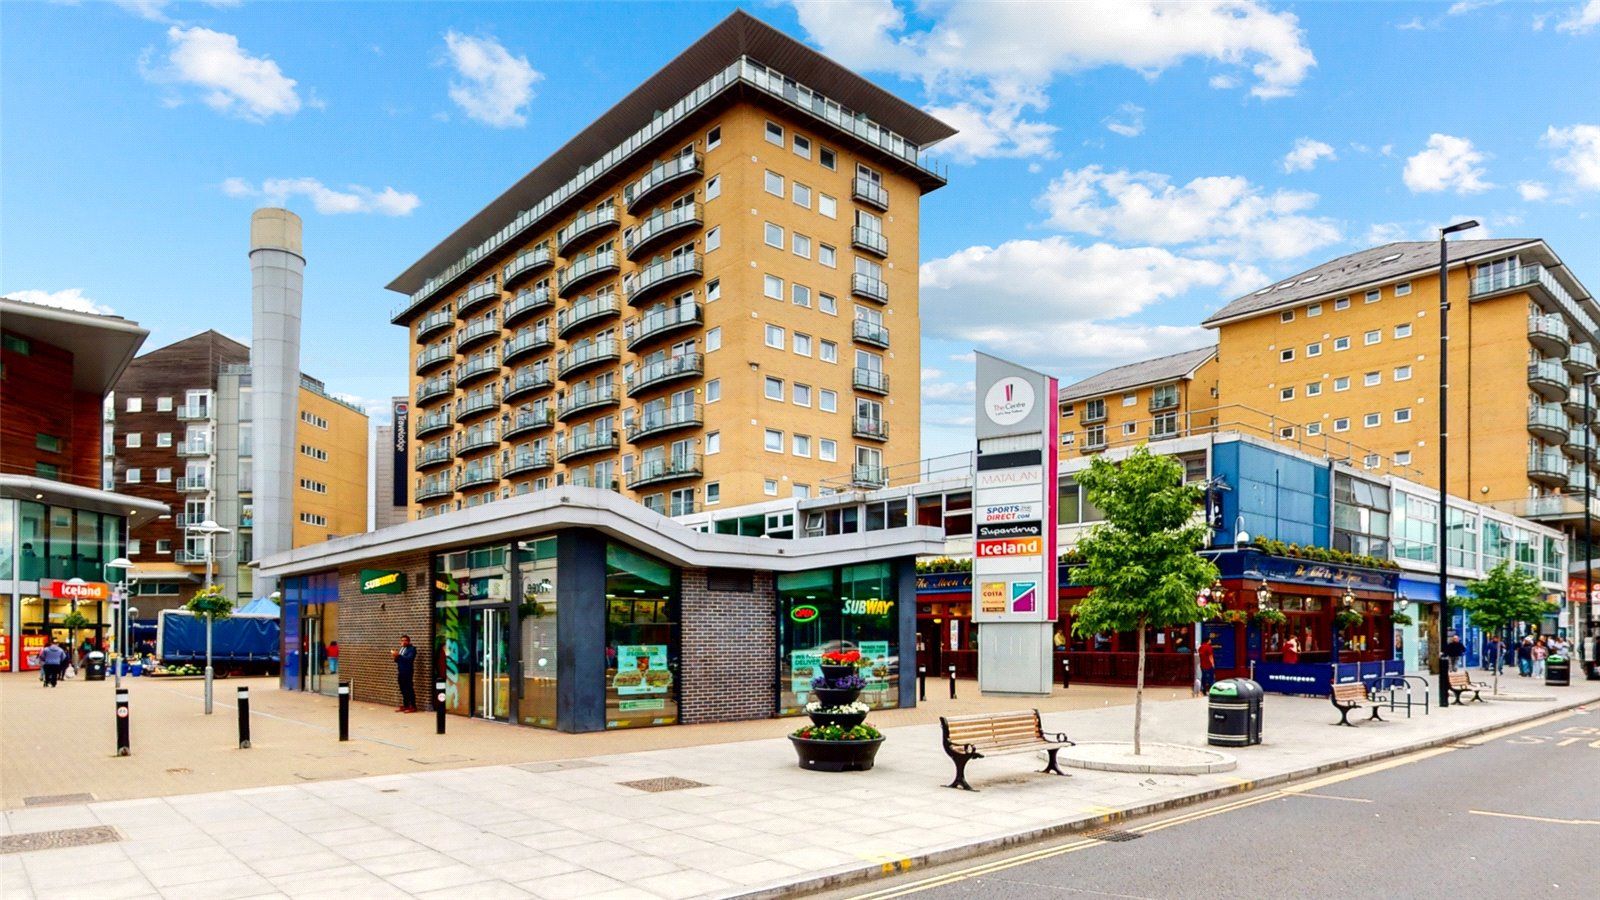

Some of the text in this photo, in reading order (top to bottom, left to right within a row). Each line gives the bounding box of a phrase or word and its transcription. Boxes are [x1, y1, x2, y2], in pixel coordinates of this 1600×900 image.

[981, 471, 1038, 485] MATALAN
[986, 505, 1019, 514] SPORTS
[986, 512, 1016, 521] DIRECT
[980, 526, 1038, 536] Superdrug
[980, 540, 1038, 556] Iceland
[363, 573, 400, 590] SUBWAY
[61, 583, 101, 597] Iceland
[841, 600, 894, 615] SUBWAY
